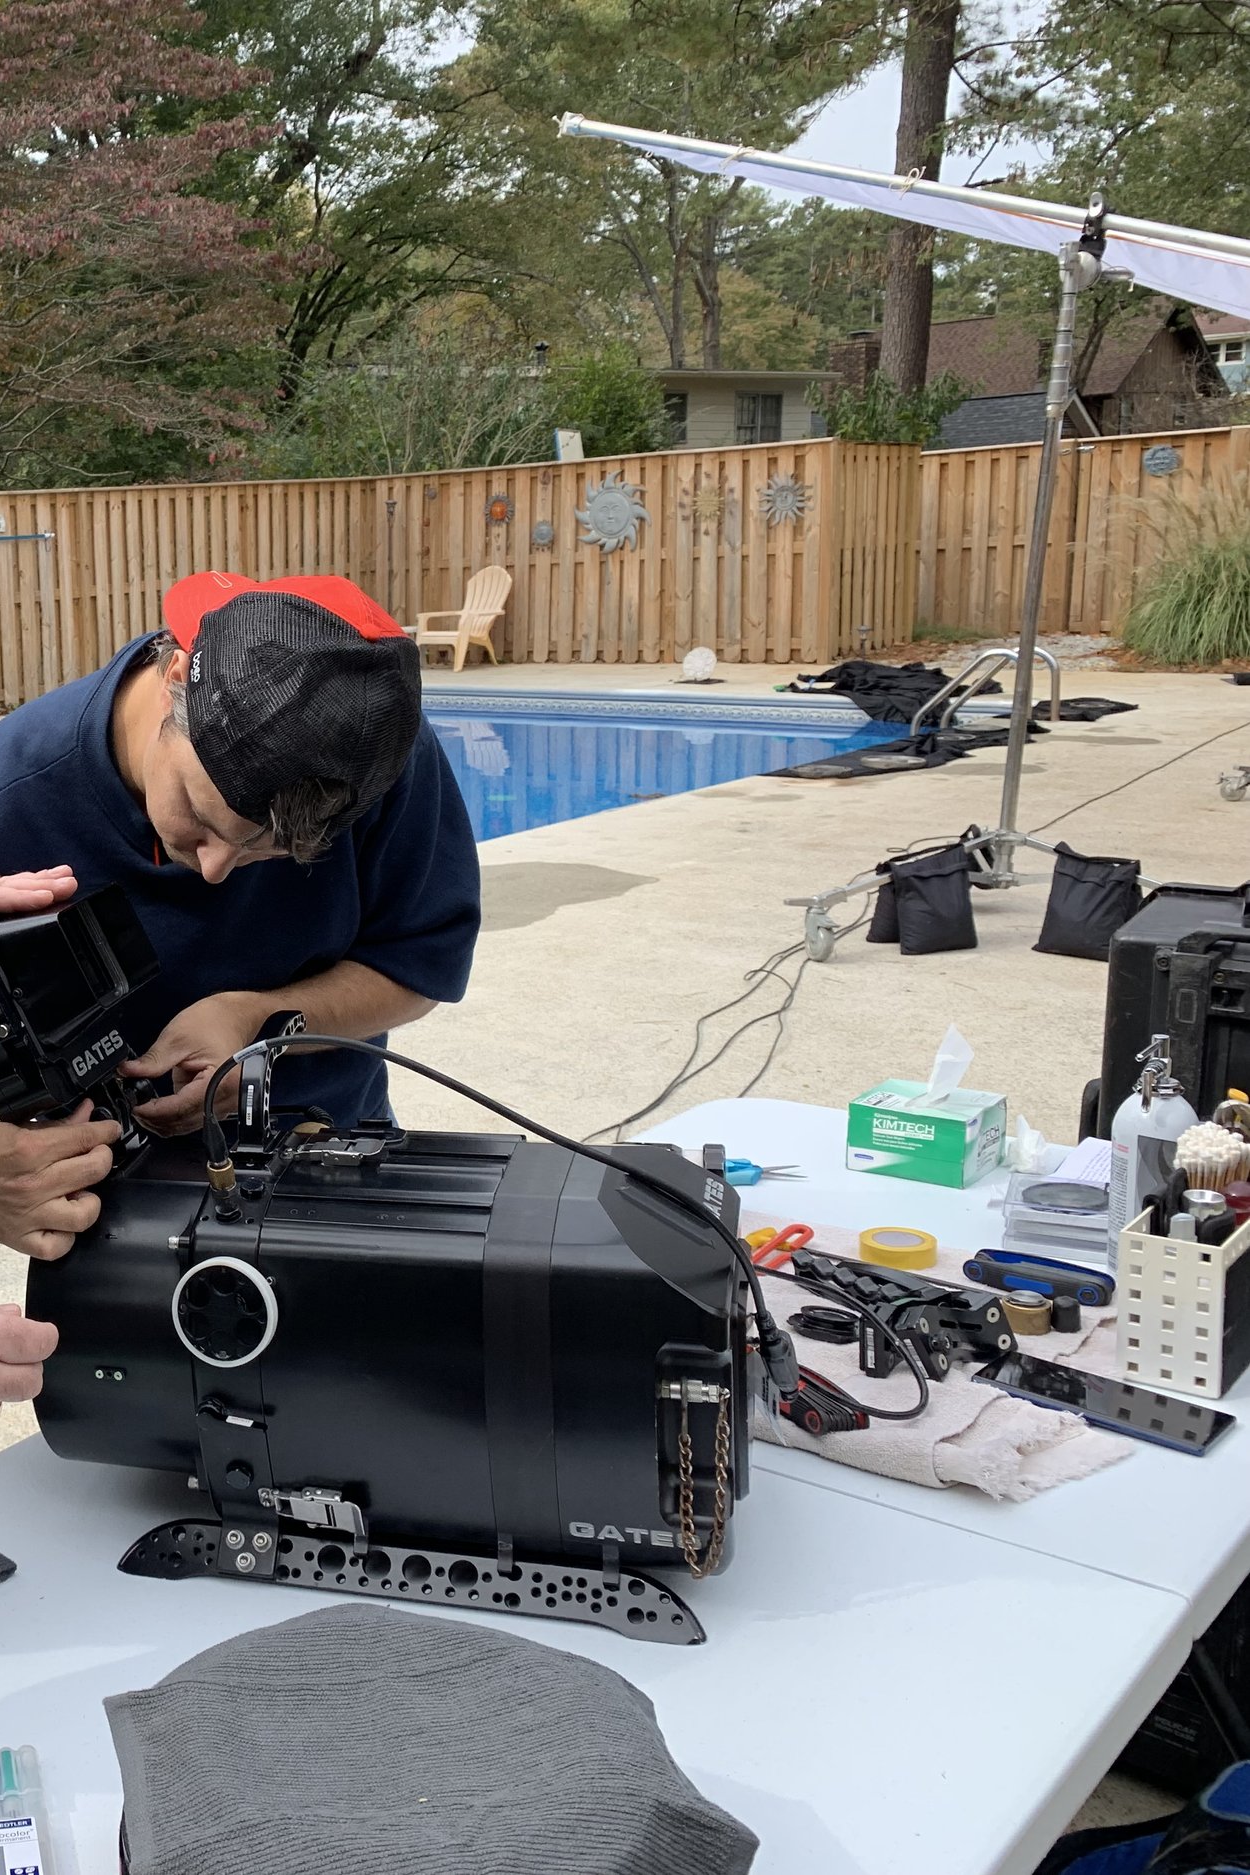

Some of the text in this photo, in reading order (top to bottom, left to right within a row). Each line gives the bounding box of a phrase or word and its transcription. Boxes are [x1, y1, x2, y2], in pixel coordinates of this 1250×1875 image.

[72, 1029, 124, 1077] GATES
[872, 1117, 936, 1135] KIMTECH
[703, 1177, 724, 1220] ATES
